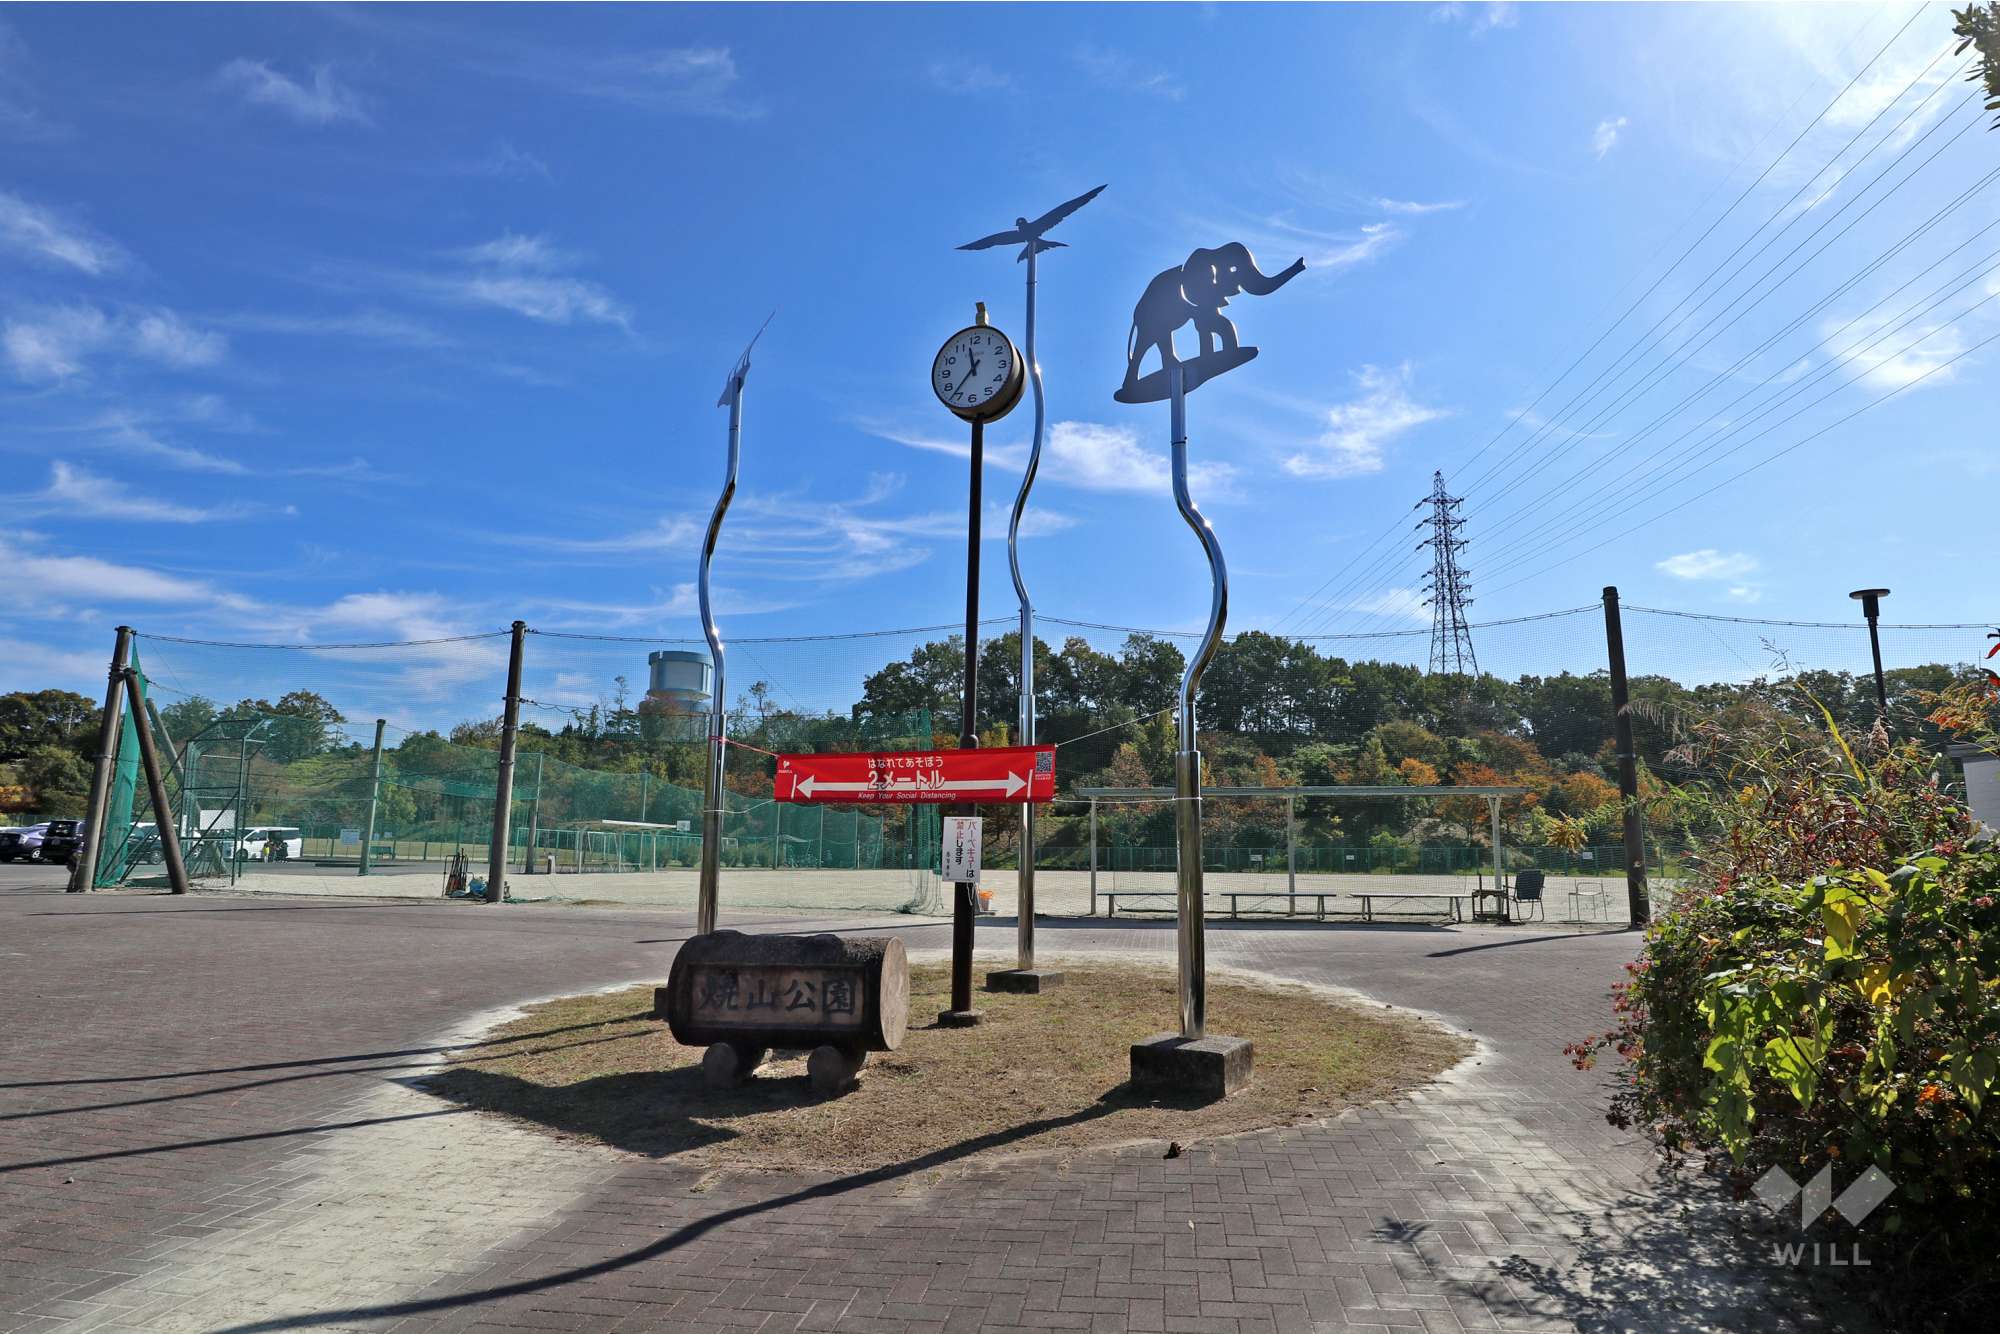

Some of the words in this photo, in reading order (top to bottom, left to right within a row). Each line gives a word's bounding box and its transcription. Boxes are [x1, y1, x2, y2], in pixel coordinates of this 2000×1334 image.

[969, 335, 981, 345] 12
[956, 344, 966, 353] 11
[994, 346, 1003, 355] 2
[945, 357, 956, 366] 10
[998, 360, 1007, 368] 3
[942, 370, 951, 378] 9
[993, 374, 1002, 382] 4
[944, 383, 953, 391] 8
[984, 387, 993, 395] 5
[955, 391, 964, 400] 7
[968, 394, 977, 403] 6
[868, 755, 944, 768] はなれてあそぼう
[868, 770, 945, 790] 2メートル
[858, 791, 875, 799] Keep
[879, 791, 893, 799] Your
[896, 791, 917, 799] Social
[920, 791, 956, 800] Distancing
[966, 821, 977, 878] バーベキューは
